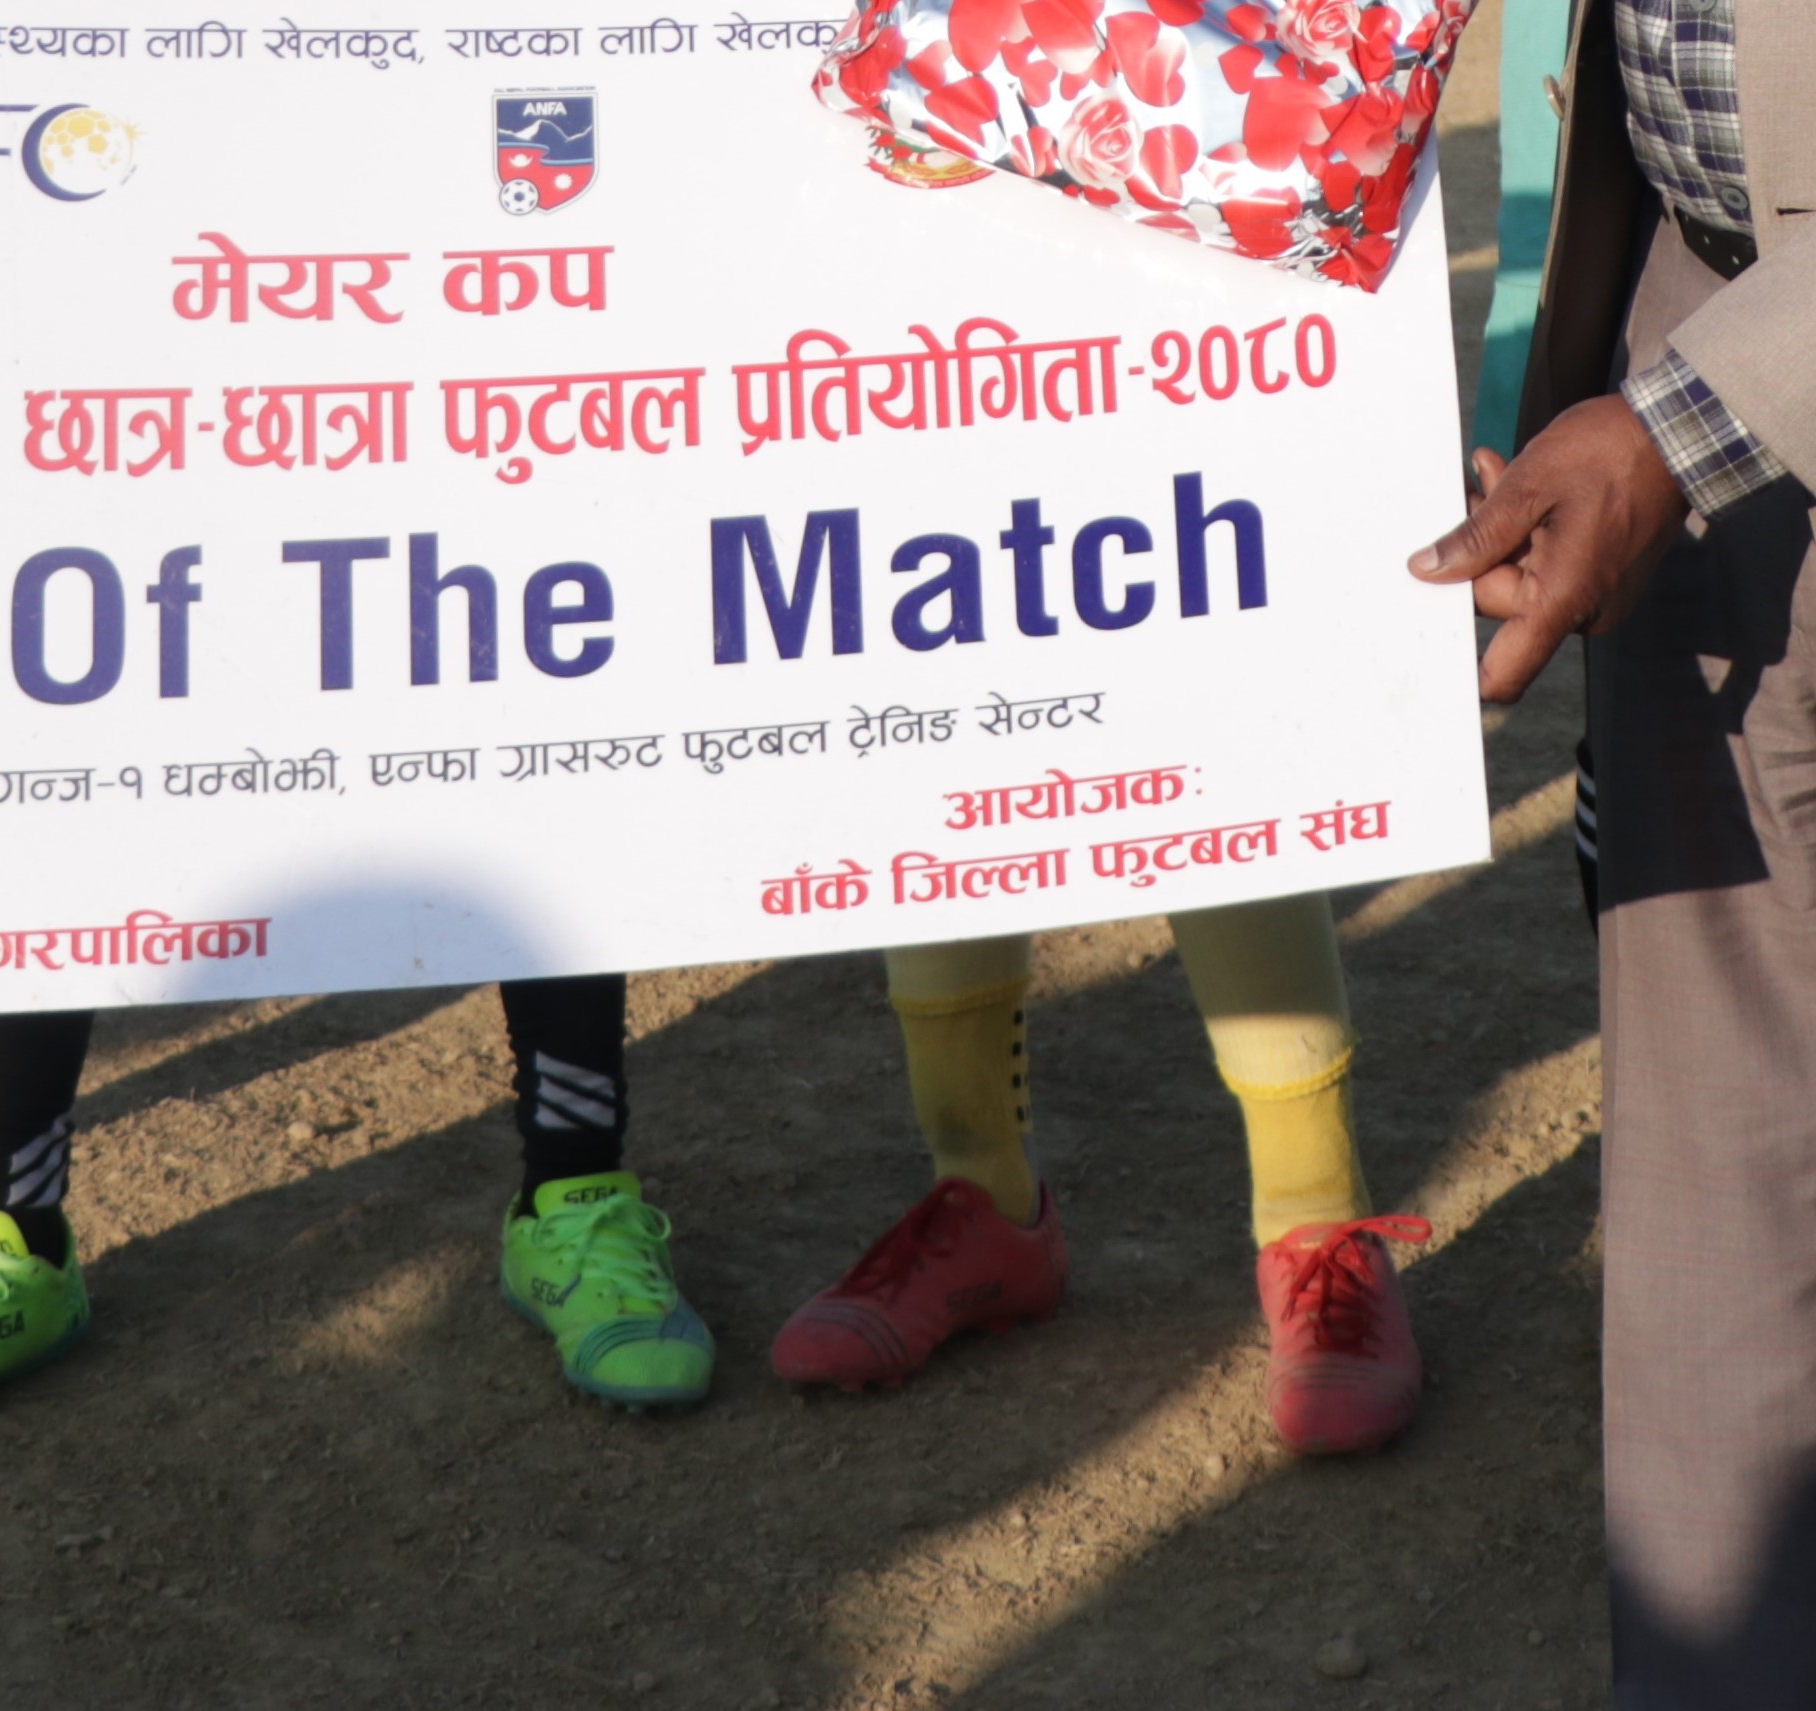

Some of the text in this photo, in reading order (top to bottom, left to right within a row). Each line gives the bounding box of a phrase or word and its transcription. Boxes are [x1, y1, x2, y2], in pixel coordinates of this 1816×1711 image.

[146, 21, 245, 57] लागि
[600, 18, 696, 54] लागि
[523, 101, 567, 116] ANFA
[172, 232, 614, 324] मेयर कप
[24, 382, 413, 478] छात्र-छात्रा
[440, 368, 706, 485] फुटबल
[731, 313, 1336, 456] प्रतियोगिता-२०८०
[11, 545, 202, 705] Of
[282, 533, 614, 691] The
[710, 471, 1267, 665] Match
[370, 749, 479, 786] एन्फा
[683, 722, 828, 774] फुटबल
[977, 693, 1104, 735] सेन्टर
[761, 800, 1390, 916] बाँके जिल्ला फुटबल संघ
